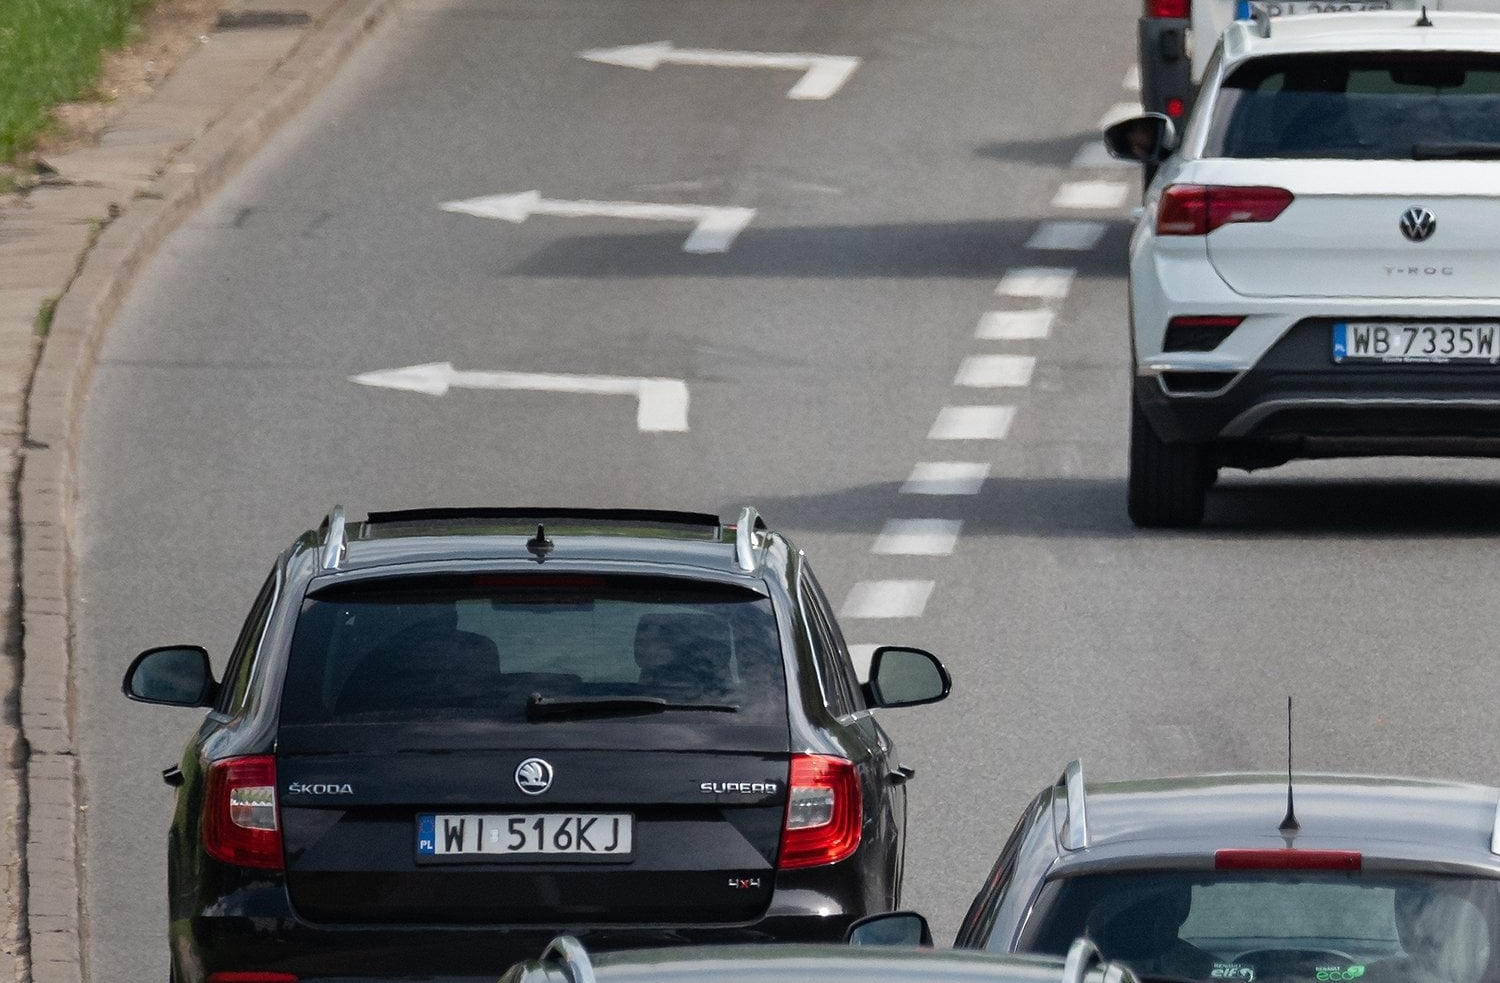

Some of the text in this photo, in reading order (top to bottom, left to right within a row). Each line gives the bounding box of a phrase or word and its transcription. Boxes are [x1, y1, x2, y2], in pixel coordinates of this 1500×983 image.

[1385, 267, 1453, 275] T-ROC
[1353, 327, 1390, 354] WB
[1403, 326, 1494, 355] 7335W
[288, 782, 777, 795] ŠKODA SUPERB
[420, 816, 620, 852] PL WI 516KJ
